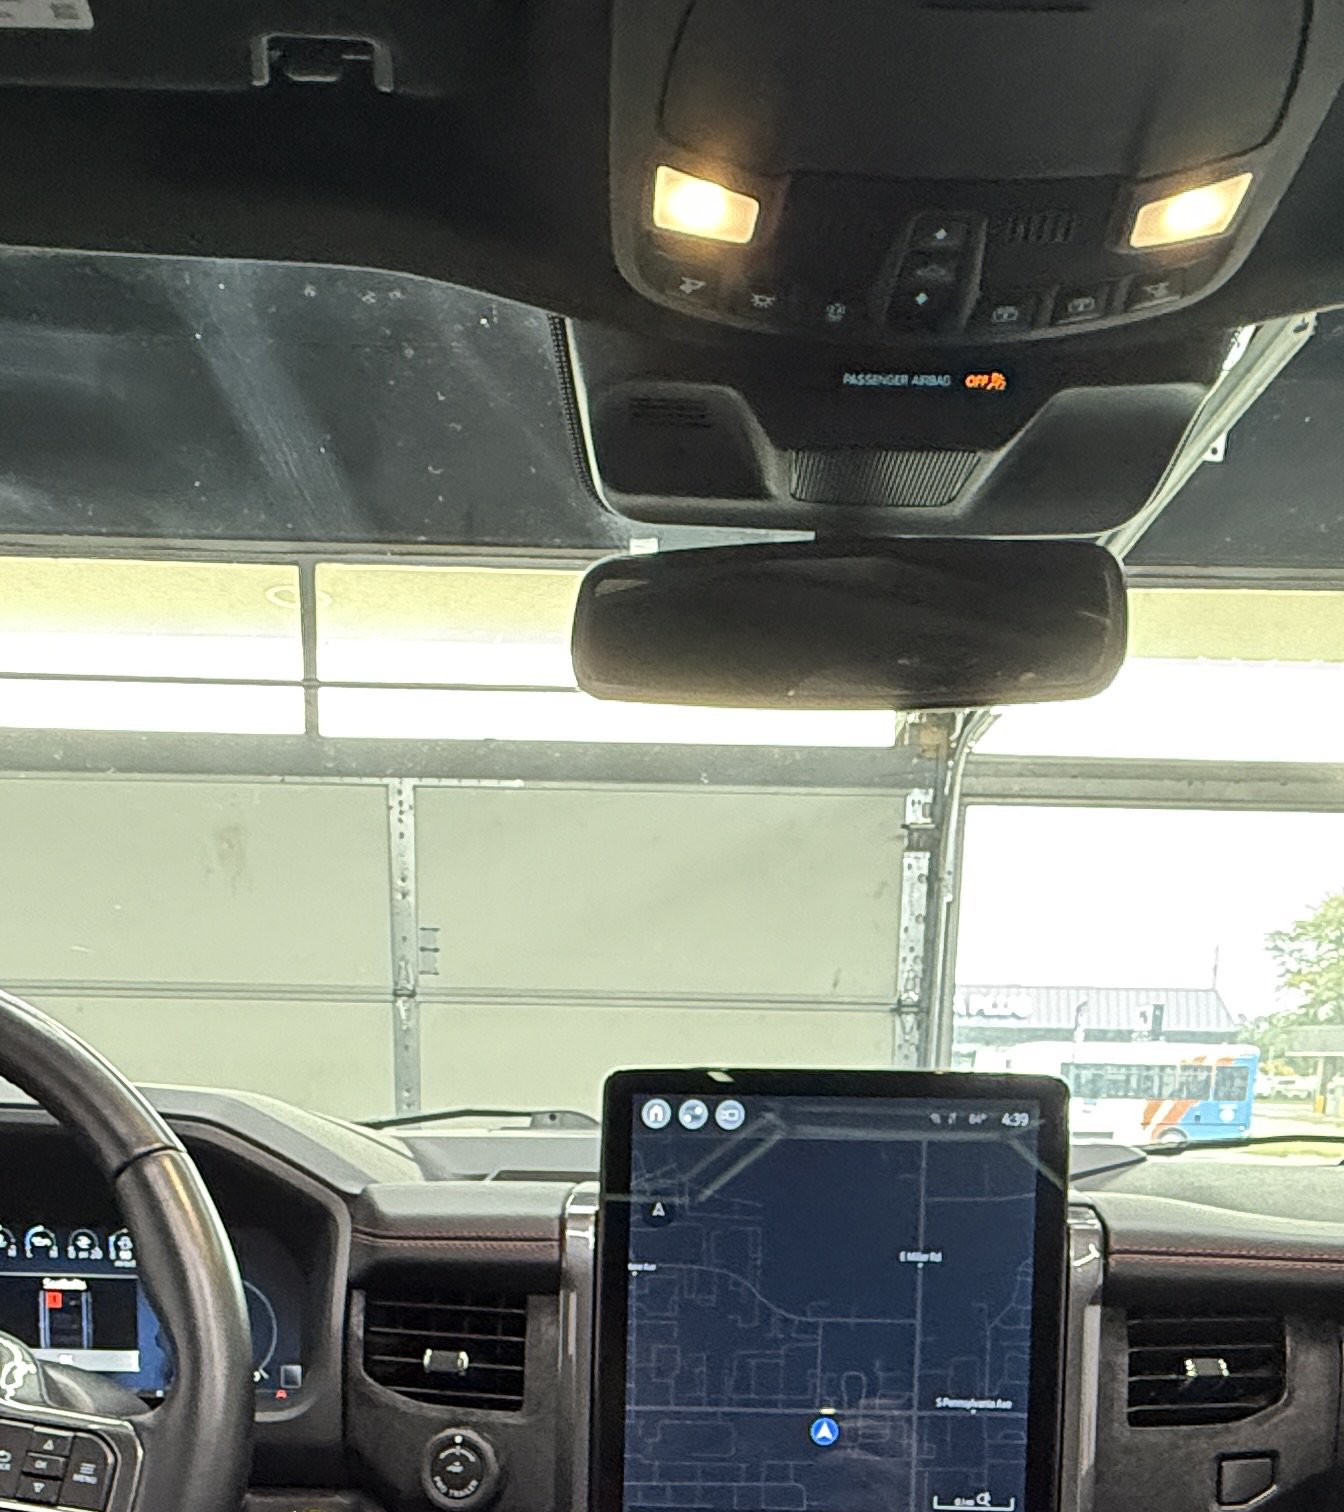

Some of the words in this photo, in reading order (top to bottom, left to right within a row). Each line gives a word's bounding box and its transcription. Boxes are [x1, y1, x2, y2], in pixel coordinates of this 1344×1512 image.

[843, 373, 908, 386] PASSENGER
[911, 374, 952, 387] AIRBAG
[965, 375, 989, 388] OFF
[1001, 1112, 1030, 1127] 4:39
